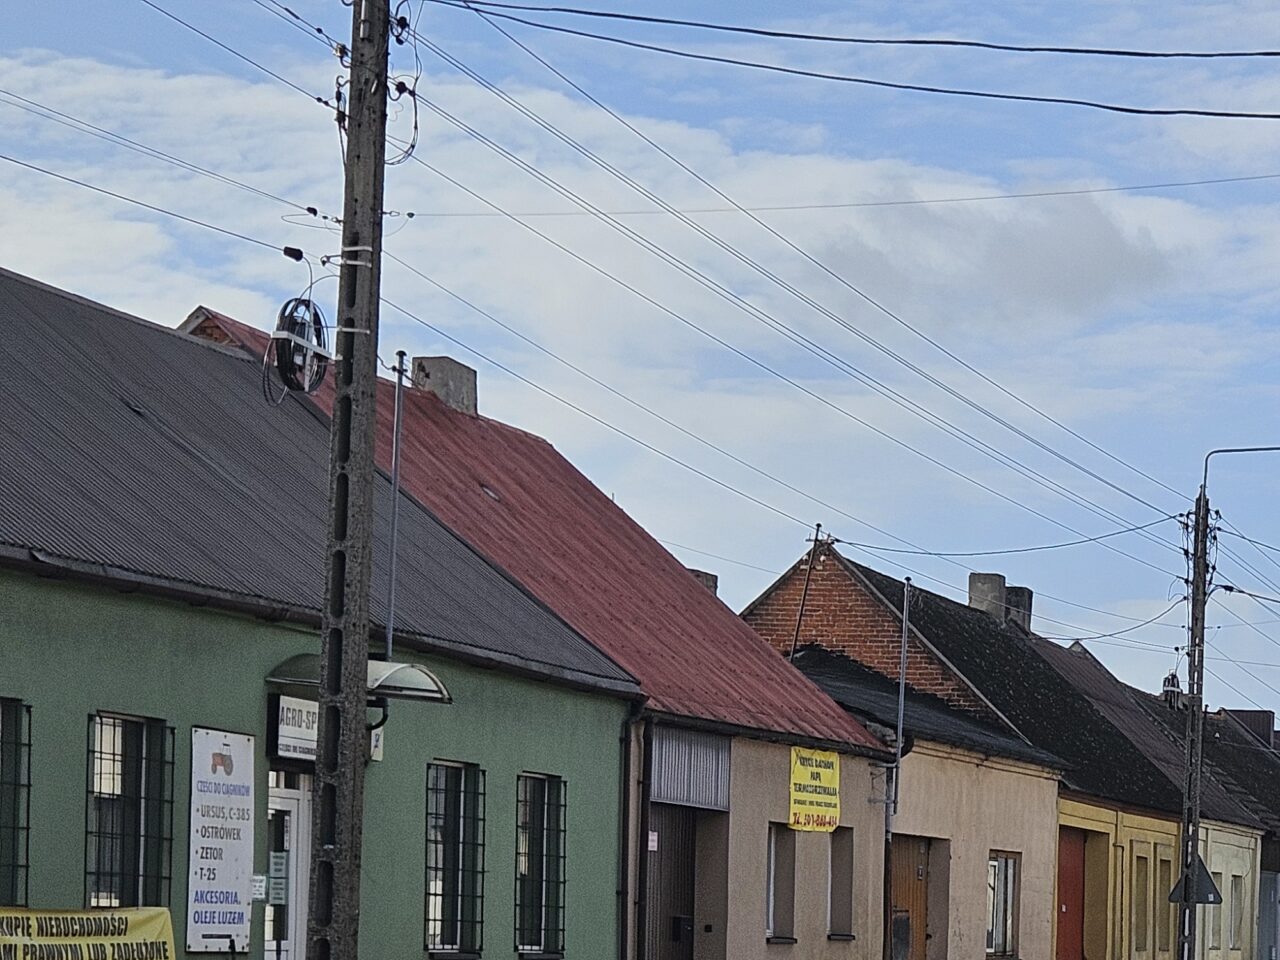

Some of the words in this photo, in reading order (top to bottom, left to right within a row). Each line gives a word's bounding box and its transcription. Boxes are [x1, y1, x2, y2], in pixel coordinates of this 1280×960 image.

[201, 804, 228, 821] URSUS,
[229, 807, 250, 821] C-385
[200, 823, 242, 840] OSTRÓWEK
[200, 846, 224, 860] ZETOR
[199, 867, 216, 881] T-25
[194, 890, 242, 905] AKCESORIA.
[36, 914, 129, 937] NIERUCHOMOŚCI
[193, 911, 217, 924] OLEJE
[218, 911, 245, 925] LUZEM
